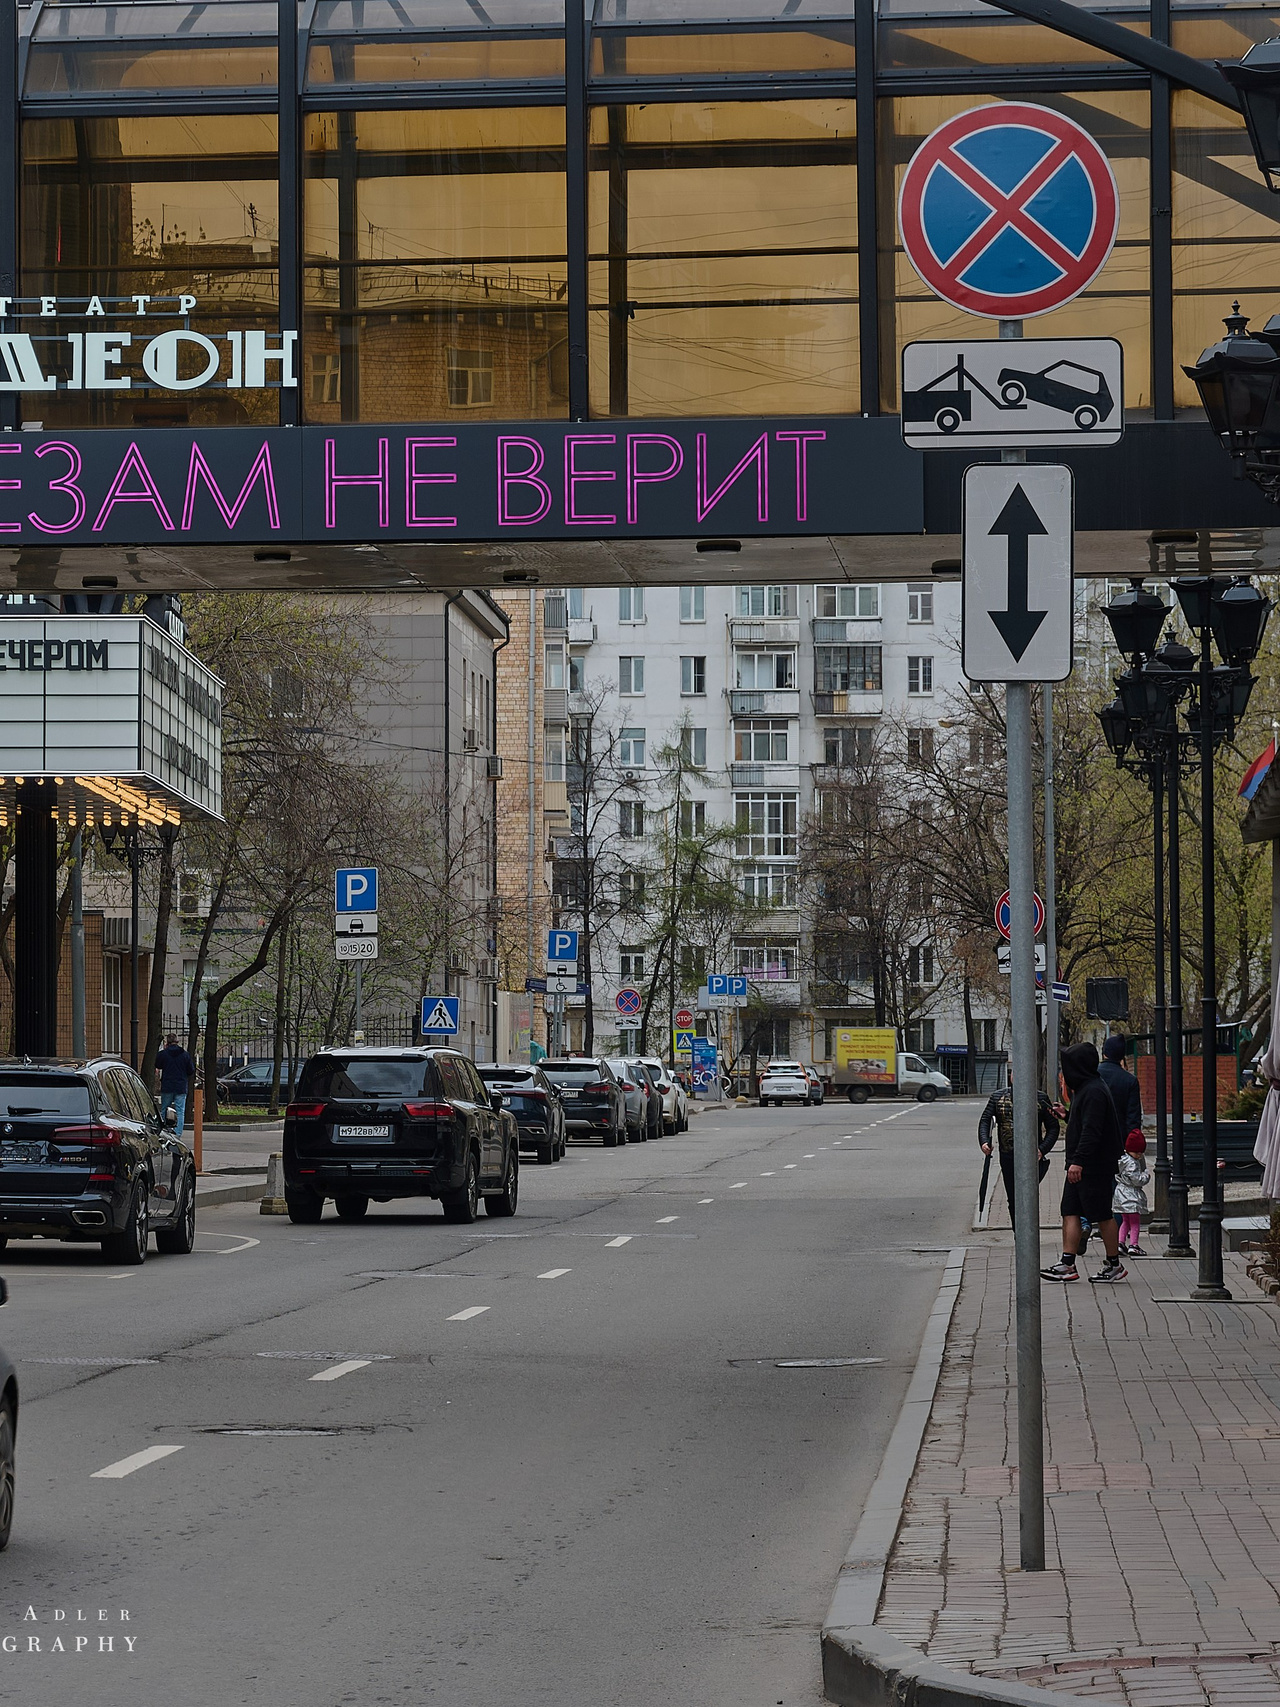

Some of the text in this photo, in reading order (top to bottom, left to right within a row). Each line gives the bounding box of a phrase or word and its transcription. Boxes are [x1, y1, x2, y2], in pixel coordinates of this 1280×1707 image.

[324, 436, 458, 529] НЕ
[496, 430, 827, 526] ВЕРИТ
[346, 874, 369, 907] P
[349, 944, 358, 953] 15
[360, 943, 373, 953] 20
[555, 934, 572, 957] P
[712, 977, 724, 993] P
[732, 979, 743, 994] P
